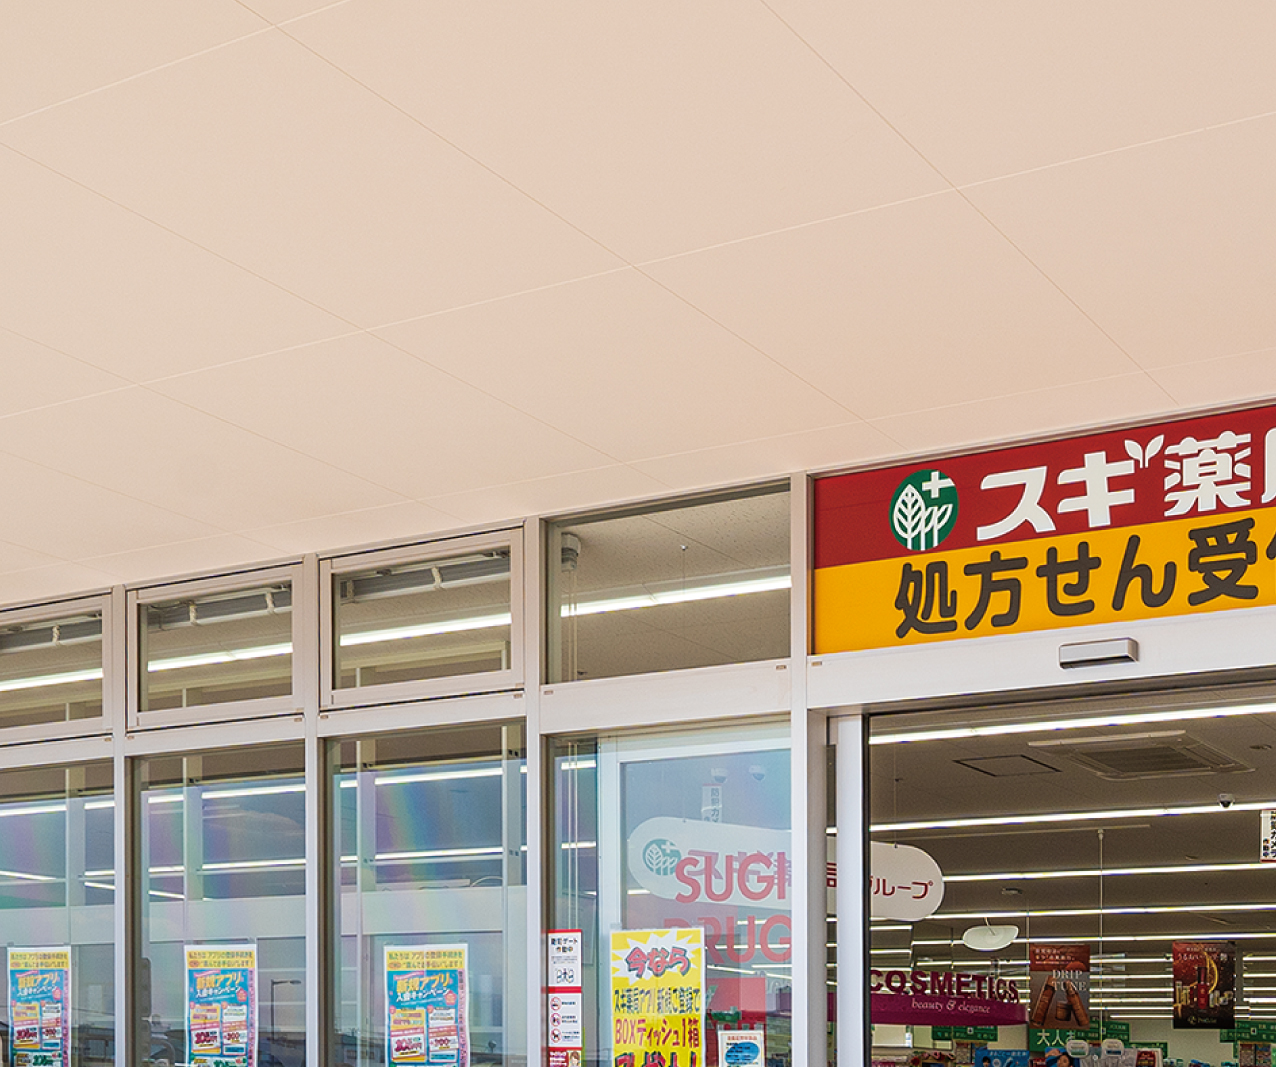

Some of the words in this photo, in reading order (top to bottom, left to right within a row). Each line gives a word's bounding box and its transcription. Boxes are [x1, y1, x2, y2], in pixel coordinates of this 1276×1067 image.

[675, 853, 786, 904] SUGI
[871, 875, 933, 900] ループ
[664, 915, 791, 964] RUG
[625, 947, 691, 978] 今なら
[396, 972, 450, 993] 新規アプリ
[871, 969, 1020, 1004] COSMETICS
[912, 998, 944, 1012] beauty
[615, 1018, 700, 1048] BOXティッシュ1箱
